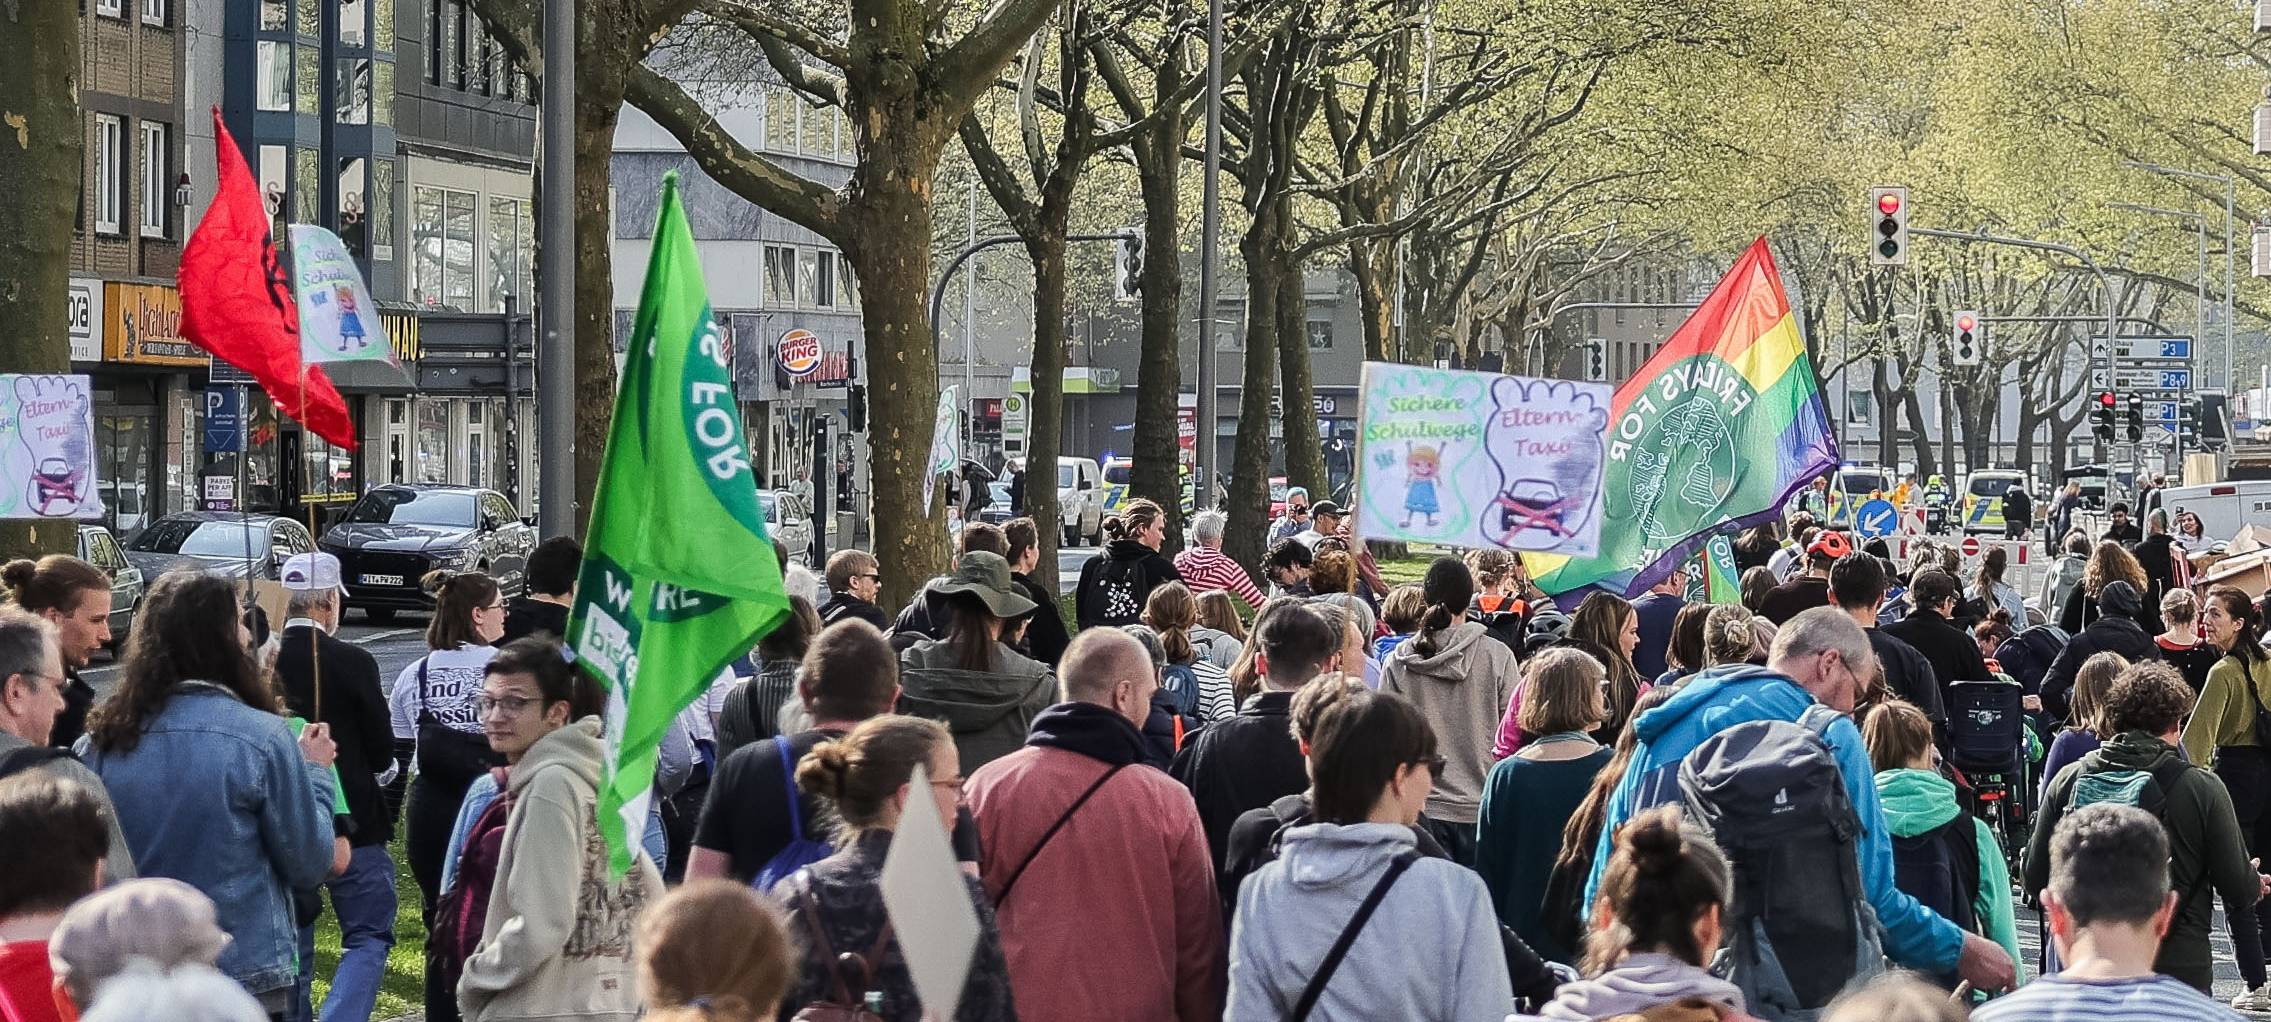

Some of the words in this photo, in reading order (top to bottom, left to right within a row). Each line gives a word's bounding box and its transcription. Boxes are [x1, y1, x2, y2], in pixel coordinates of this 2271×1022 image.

[780, 336, 817, 353] BURGER
[781, 345, 818, 364] KING
[24, 399, 74, 419] Eltern-
[207, 391, 224, 418] P
[1387, 395, 1466, 414] Sichere
[1501, 406, 1584, 428] Eltern-
[1367, 420, 1478, 442] Schulwege
